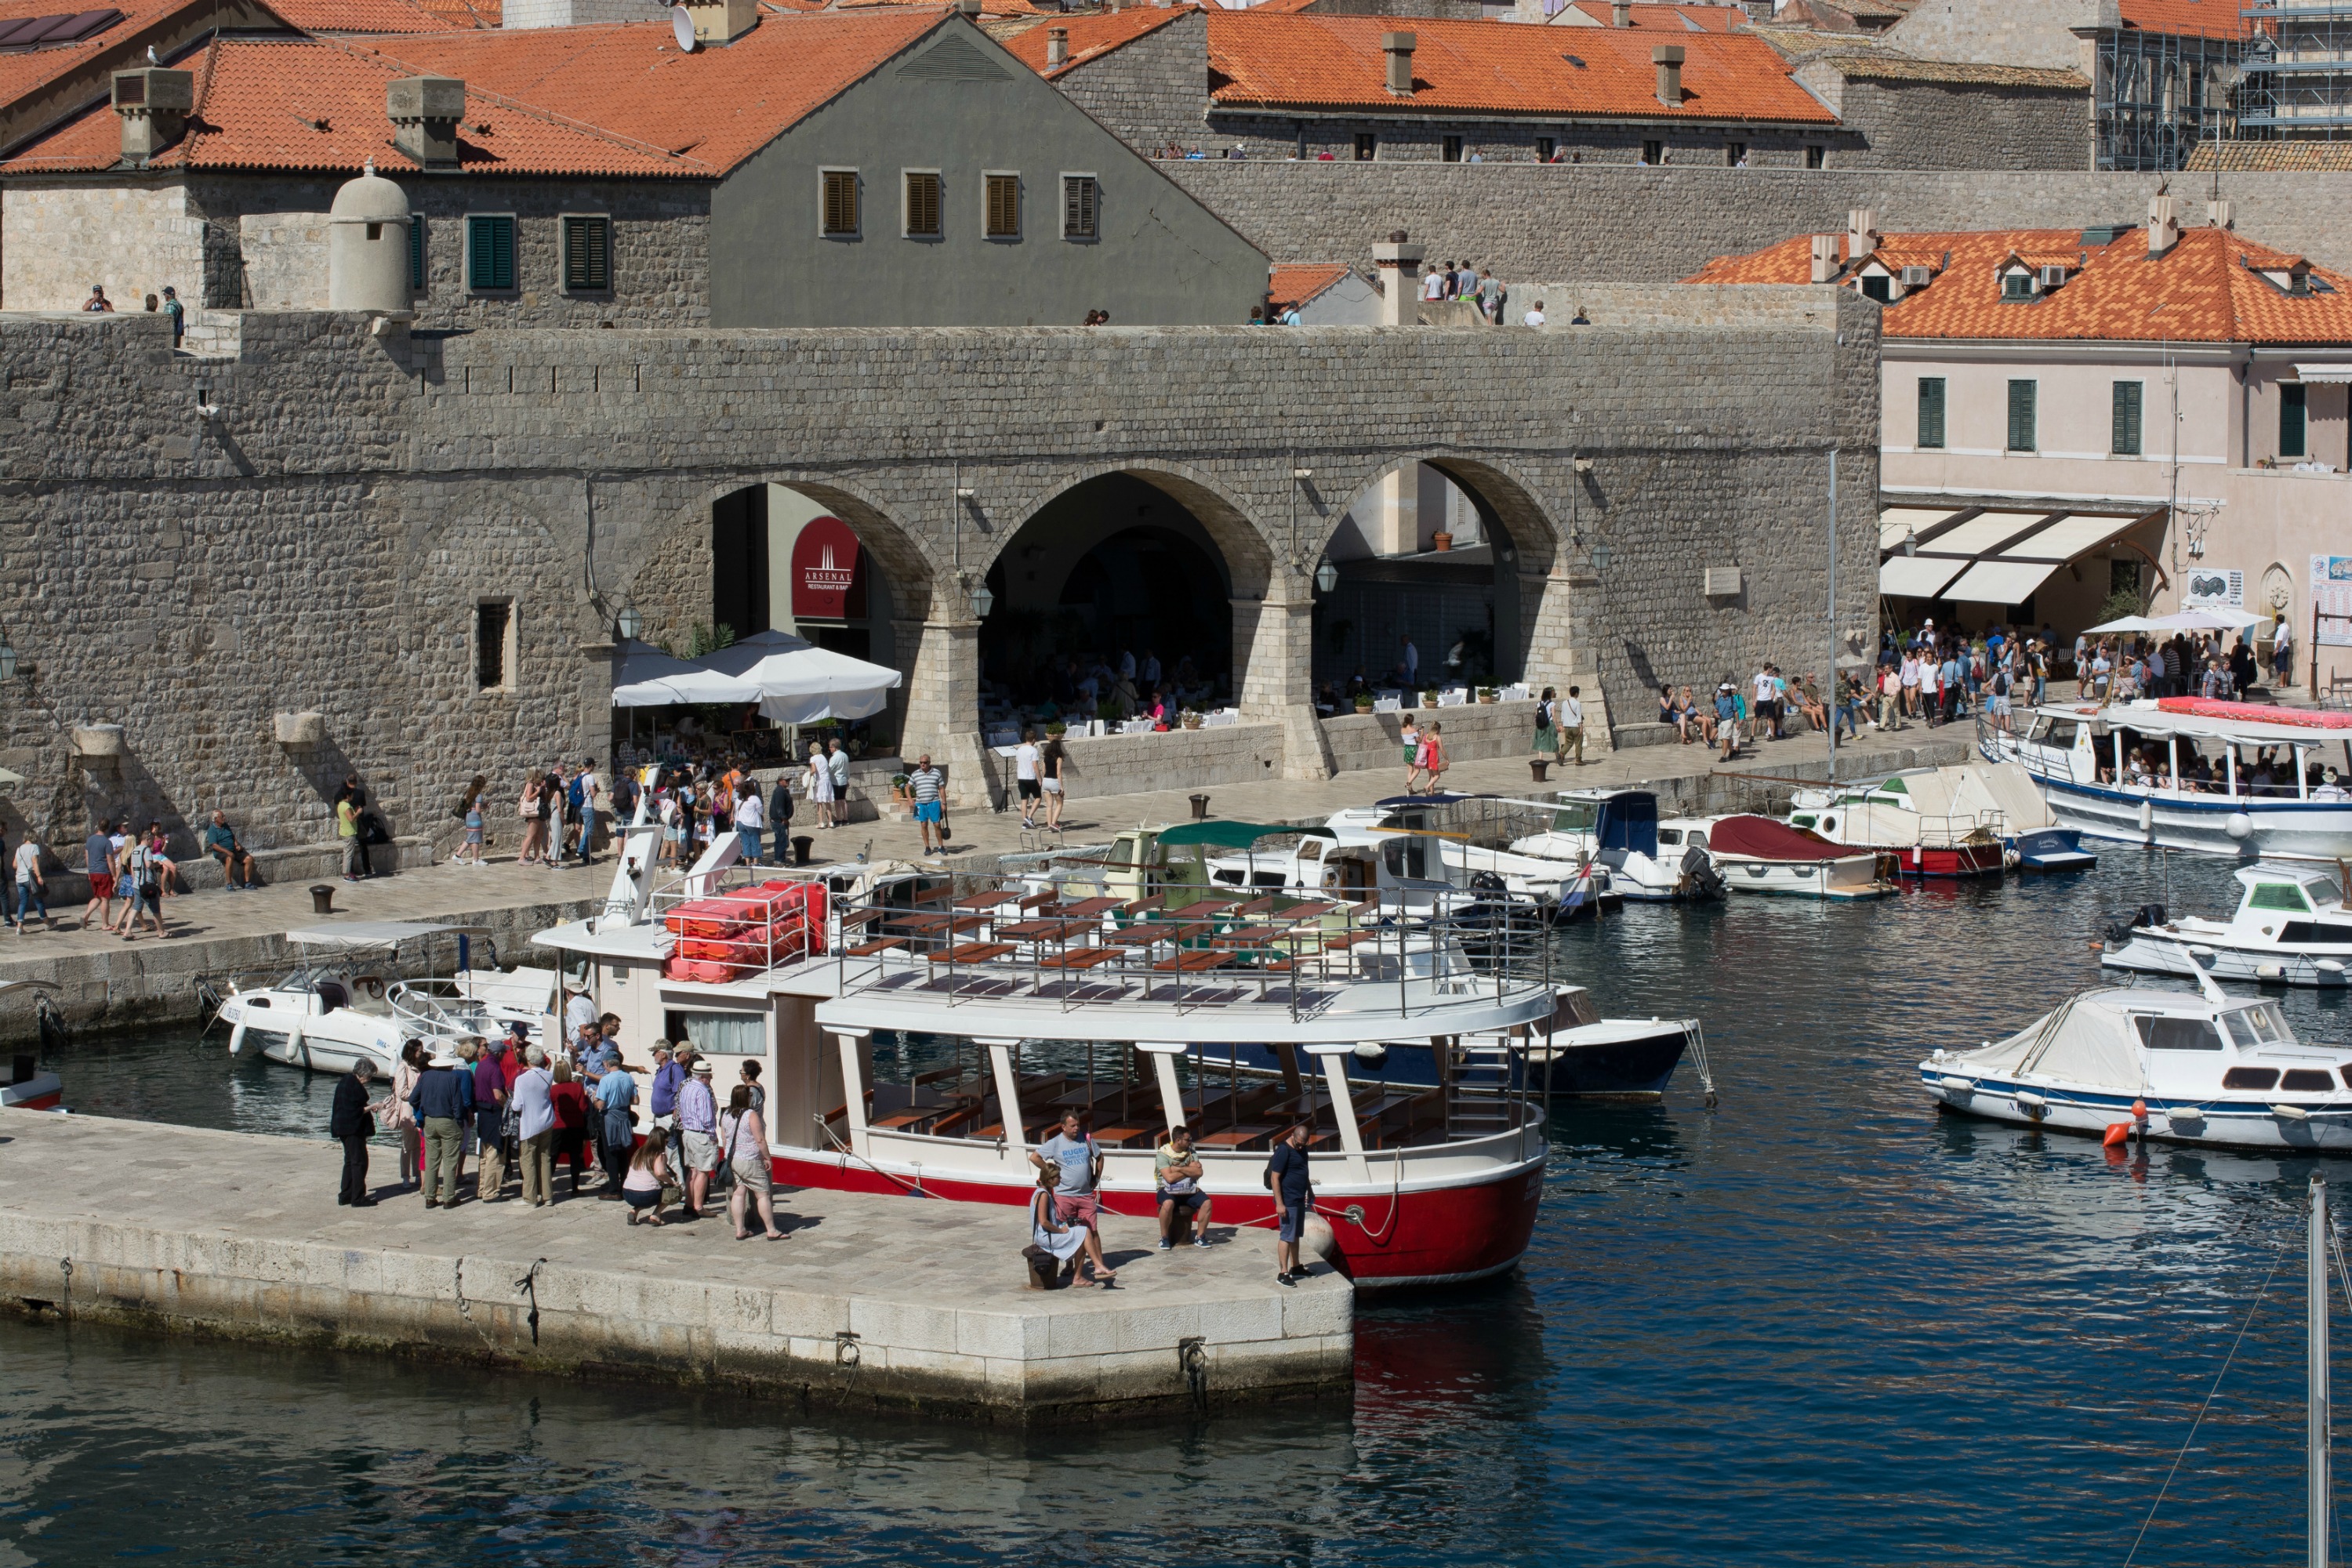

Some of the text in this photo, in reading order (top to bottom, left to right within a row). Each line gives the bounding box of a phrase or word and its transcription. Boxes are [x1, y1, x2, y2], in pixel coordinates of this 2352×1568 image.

[805, 572, 851, 581] ARSENAL
[2007, 1100, 2052, 1116] APOLO
[1062, 1147, 1087, 1156] RUGBY
